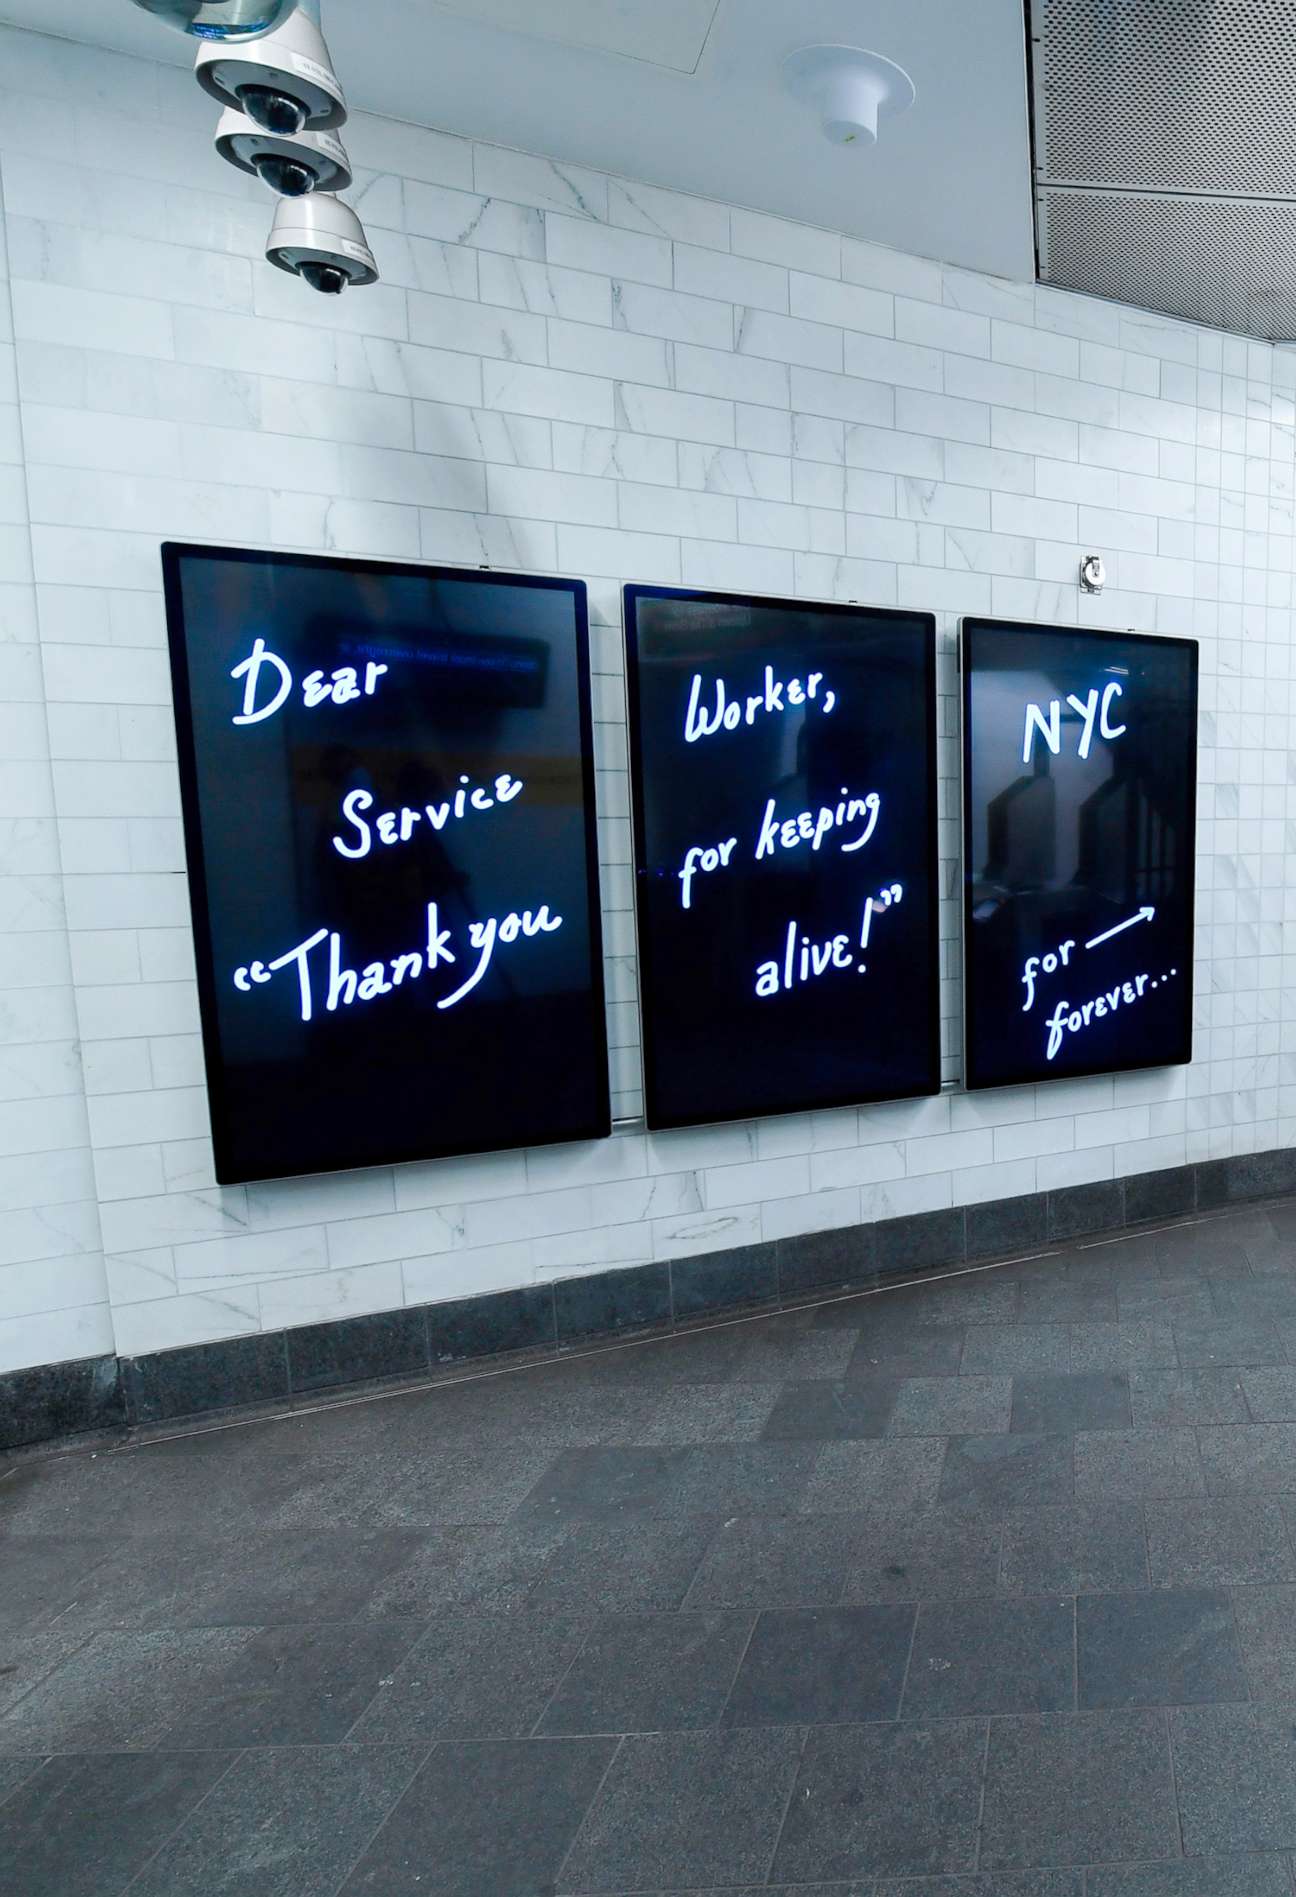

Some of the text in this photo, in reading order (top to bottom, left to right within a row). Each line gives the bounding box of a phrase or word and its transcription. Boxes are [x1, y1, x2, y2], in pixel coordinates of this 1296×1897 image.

[230, 637, 389, 726] Dear
[684, 665, 836, 743] Worker,
[1022, 682, 1127, 764] NYC
[332, 773, 523, 859] Service
[678, 787, 881, 909] for keeping
[437, 905, 563, 1009] you
[1021, 940, 1076, 1011] for
